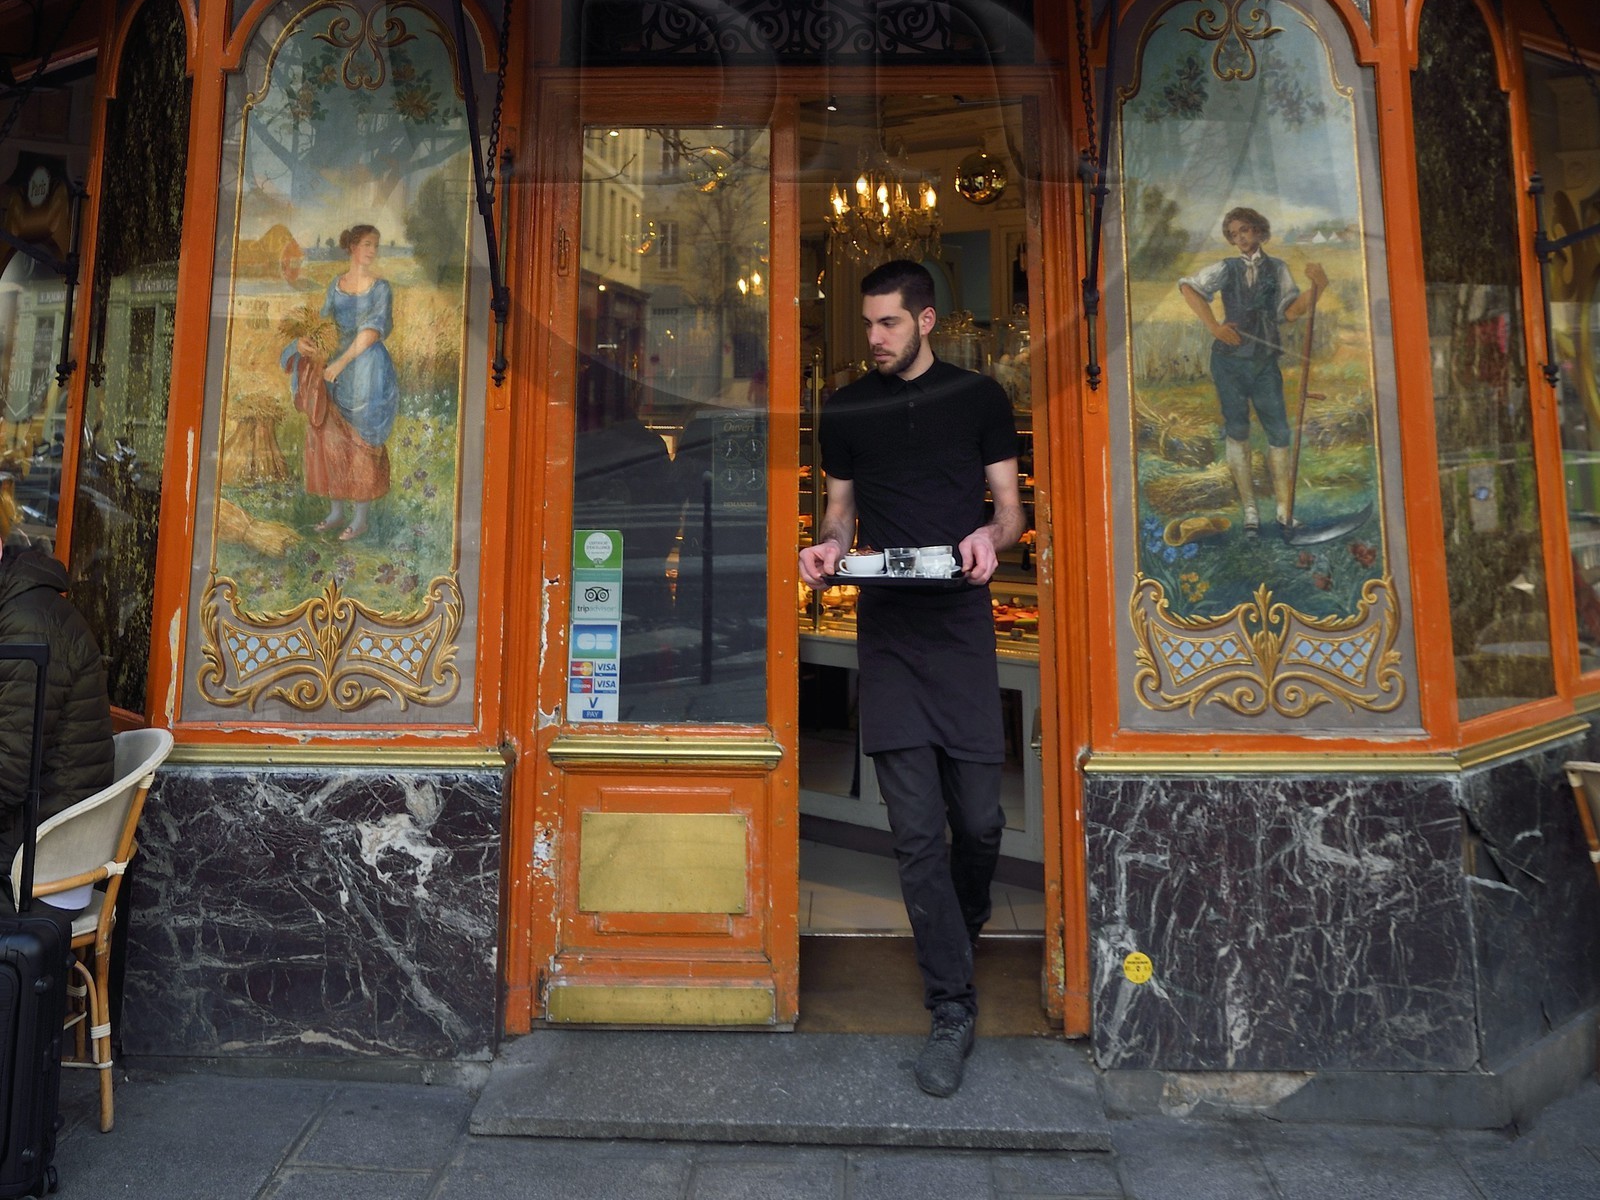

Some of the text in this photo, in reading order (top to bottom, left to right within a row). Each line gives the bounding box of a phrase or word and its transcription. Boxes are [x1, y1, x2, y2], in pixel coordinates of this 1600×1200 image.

[9, 369, 31, 393] 2014
[597, 663, 616, 671] VISA
[597, 680, 616, 688] VISA
[589, 697, 598, 708] V
